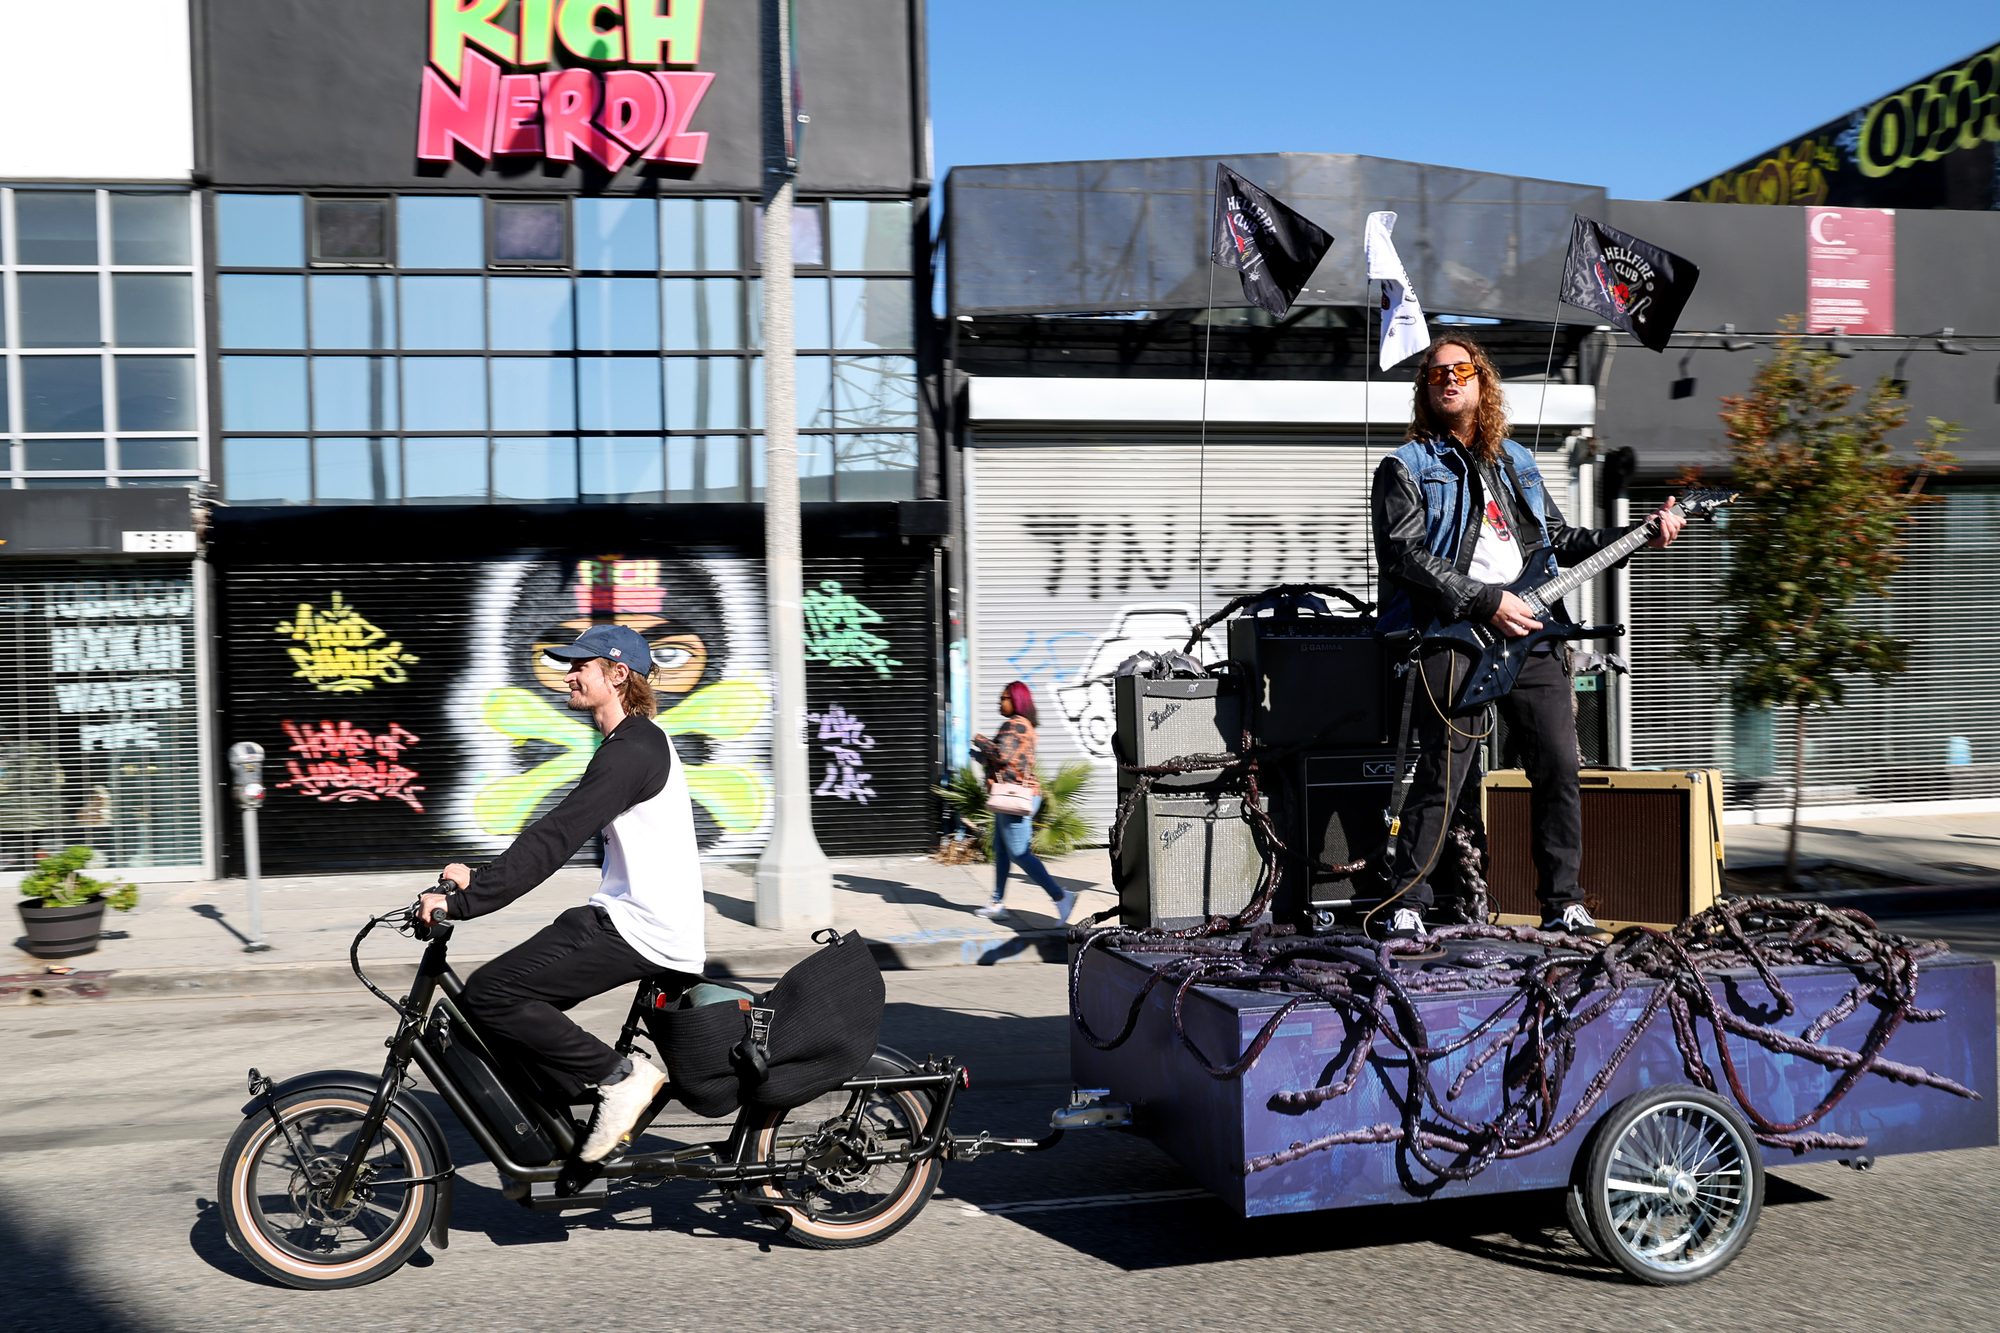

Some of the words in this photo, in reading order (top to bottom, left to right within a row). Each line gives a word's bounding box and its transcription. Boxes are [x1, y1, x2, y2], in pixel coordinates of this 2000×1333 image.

[428, 0, 704, 87] RICH
[417, 46, 716, 173] NERDZ
[1227, 195, 1277, 235] HELLFIRE
[1233, 213, 1258, 234] CLUB
[1604, 246, 1656, 281] HELLFIRE
[1615, 262, 1639, 282] CLUB
[51, 624, 183, 671] HOOKAH
[54, 680, 183, 714] WATER
